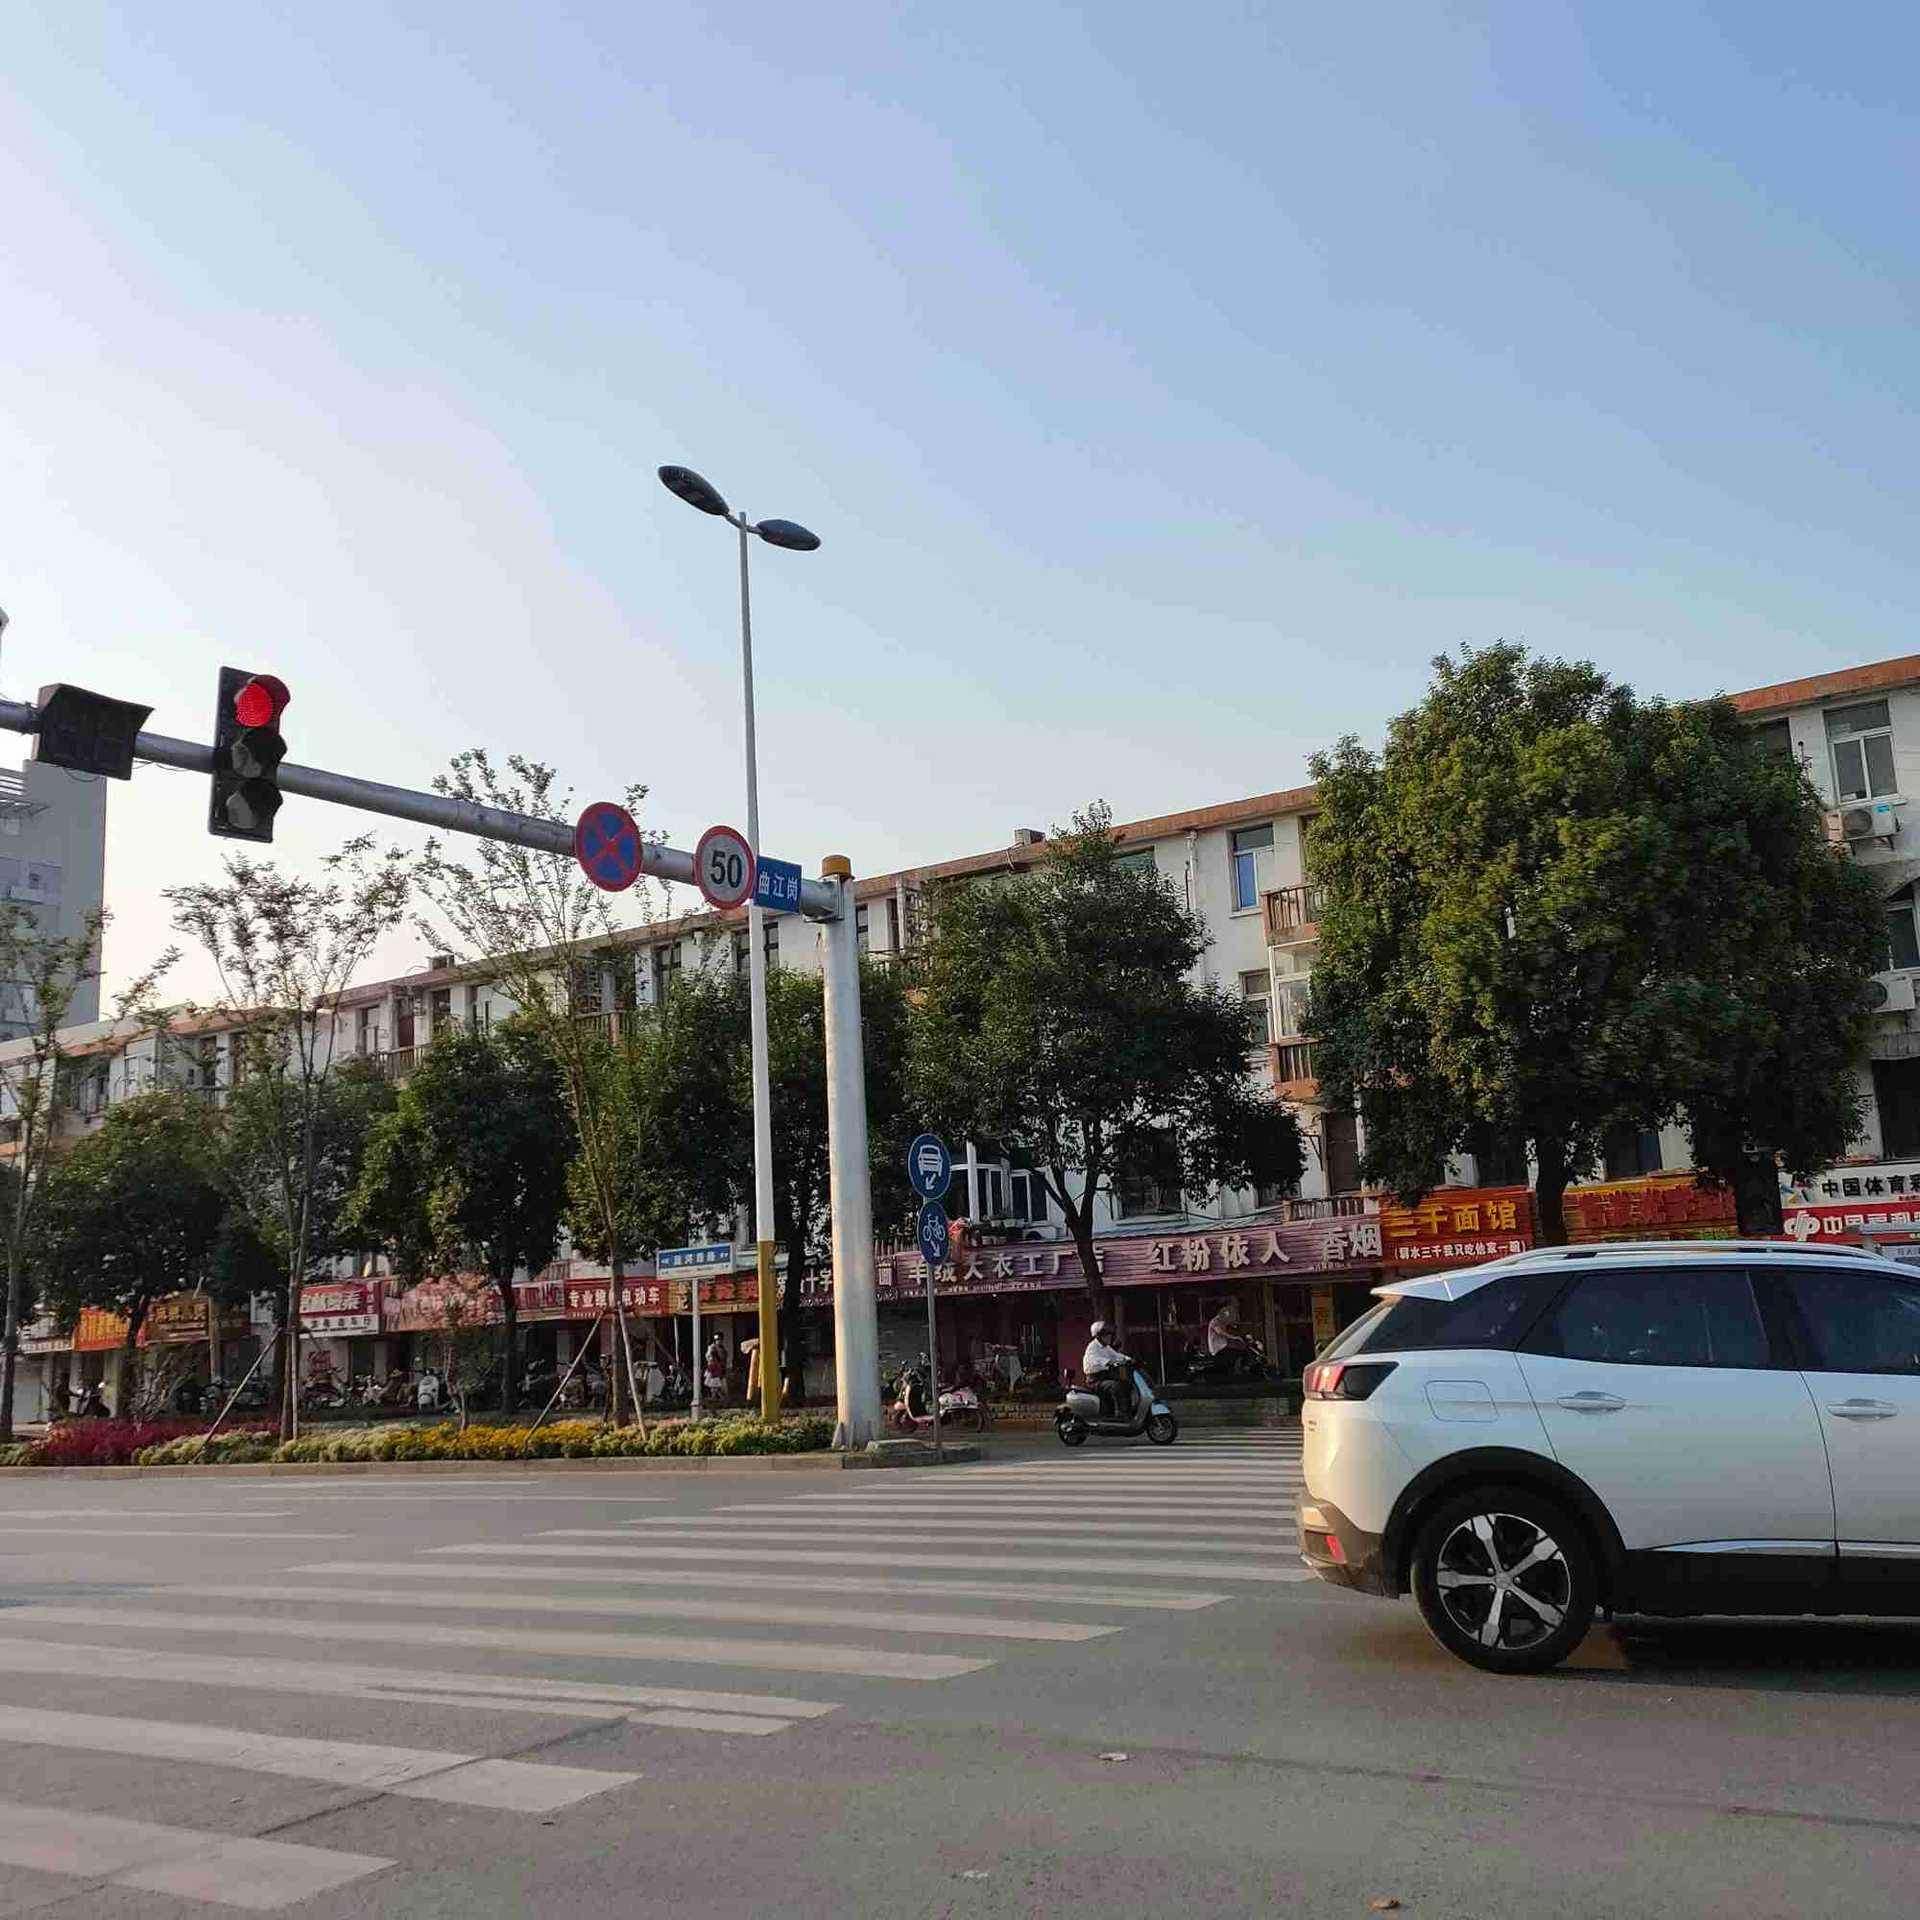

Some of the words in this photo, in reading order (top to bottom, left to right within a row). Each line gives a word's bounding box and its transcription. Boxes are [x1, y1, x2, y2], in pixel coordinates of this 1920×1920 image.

[711, 851, 742, 888] 50
[1321, 1223, 1383, 1262] 香烟
[569, 1286, 660, 1309] 专业维电动车
